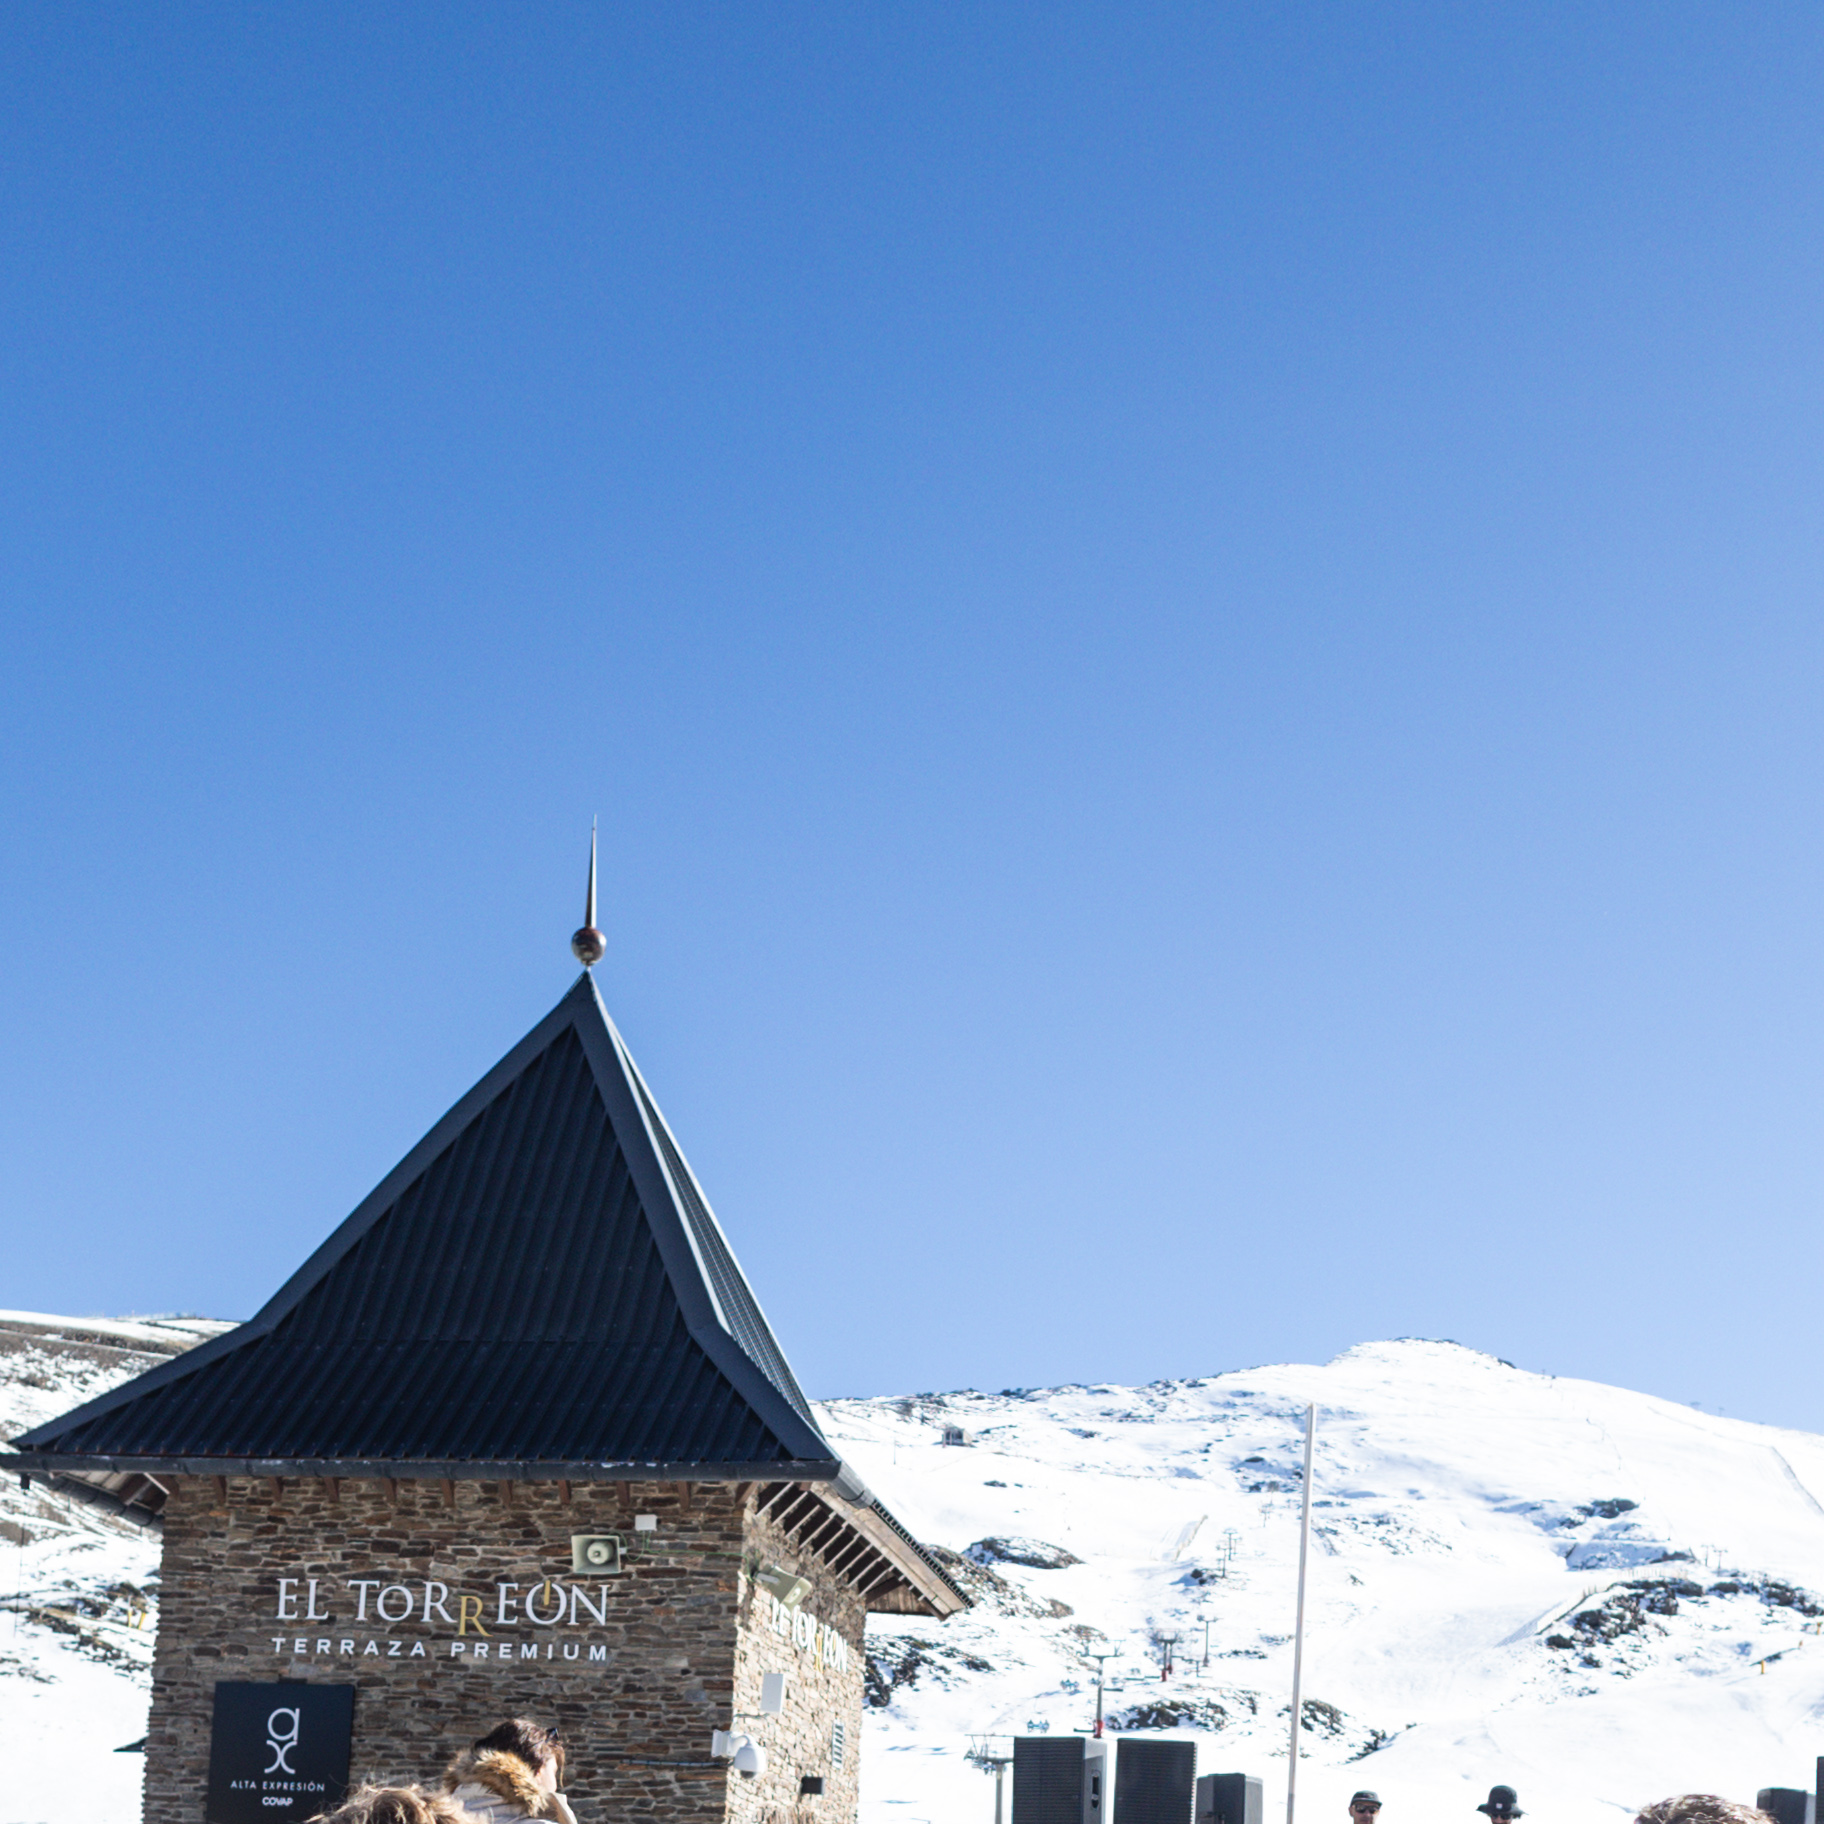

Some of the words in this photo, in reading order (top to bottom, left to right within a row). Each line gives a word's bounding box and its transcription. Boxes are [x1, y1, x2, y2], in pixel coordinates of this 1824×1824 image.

[276, 1578, 329, 1621] EL
[271, 1637, 426, 1657] TERRAZA
[450, 1642, 607, 1661] PREMIUM
[230, 1780, 256, 1790] ALTA
[262, 1780, 325, 1792] EXPRESIÓN
[262, 1796, 293, 1806] COVAP
